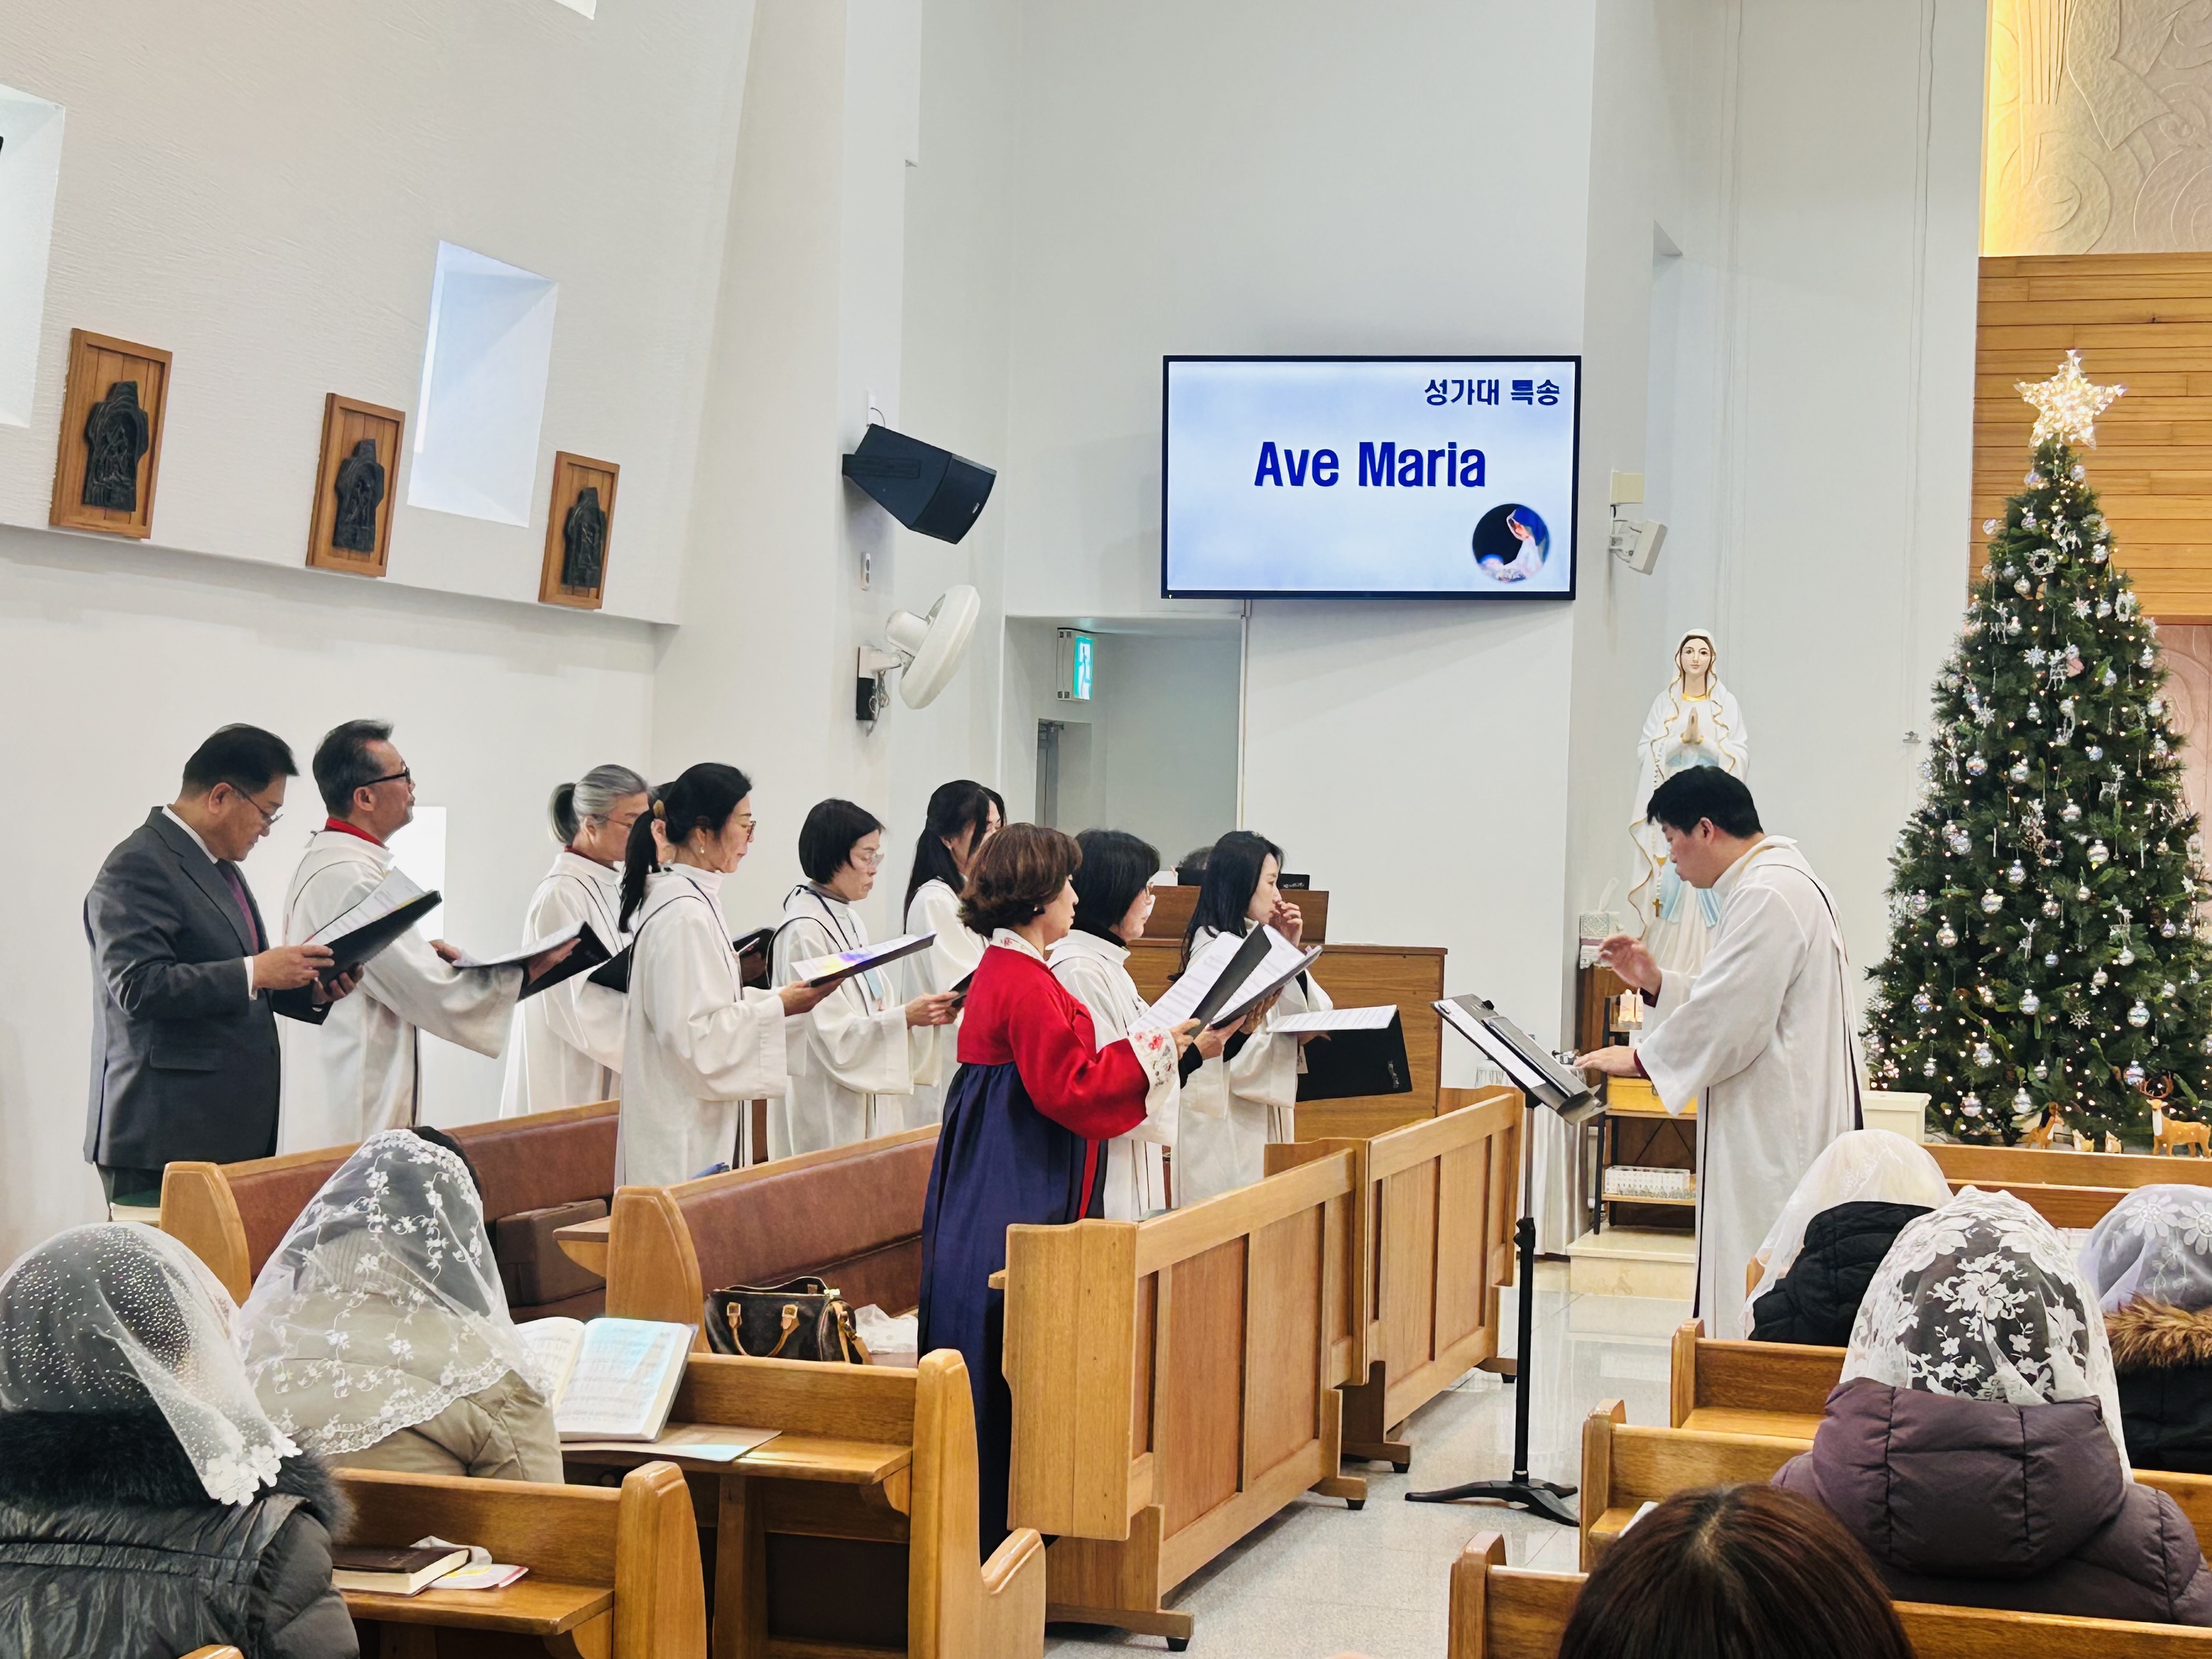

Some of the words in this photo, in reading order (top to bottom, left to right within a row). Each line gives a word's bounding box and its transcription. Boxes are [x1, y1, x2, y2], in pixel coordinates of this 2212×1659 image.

[1425, 379, 1499, 406] 성가대
[1510, 379, 1560, 406] 특송
[1254, 441, 1339, 487] Ave
[1358, 441, 1486, 488] Maria
